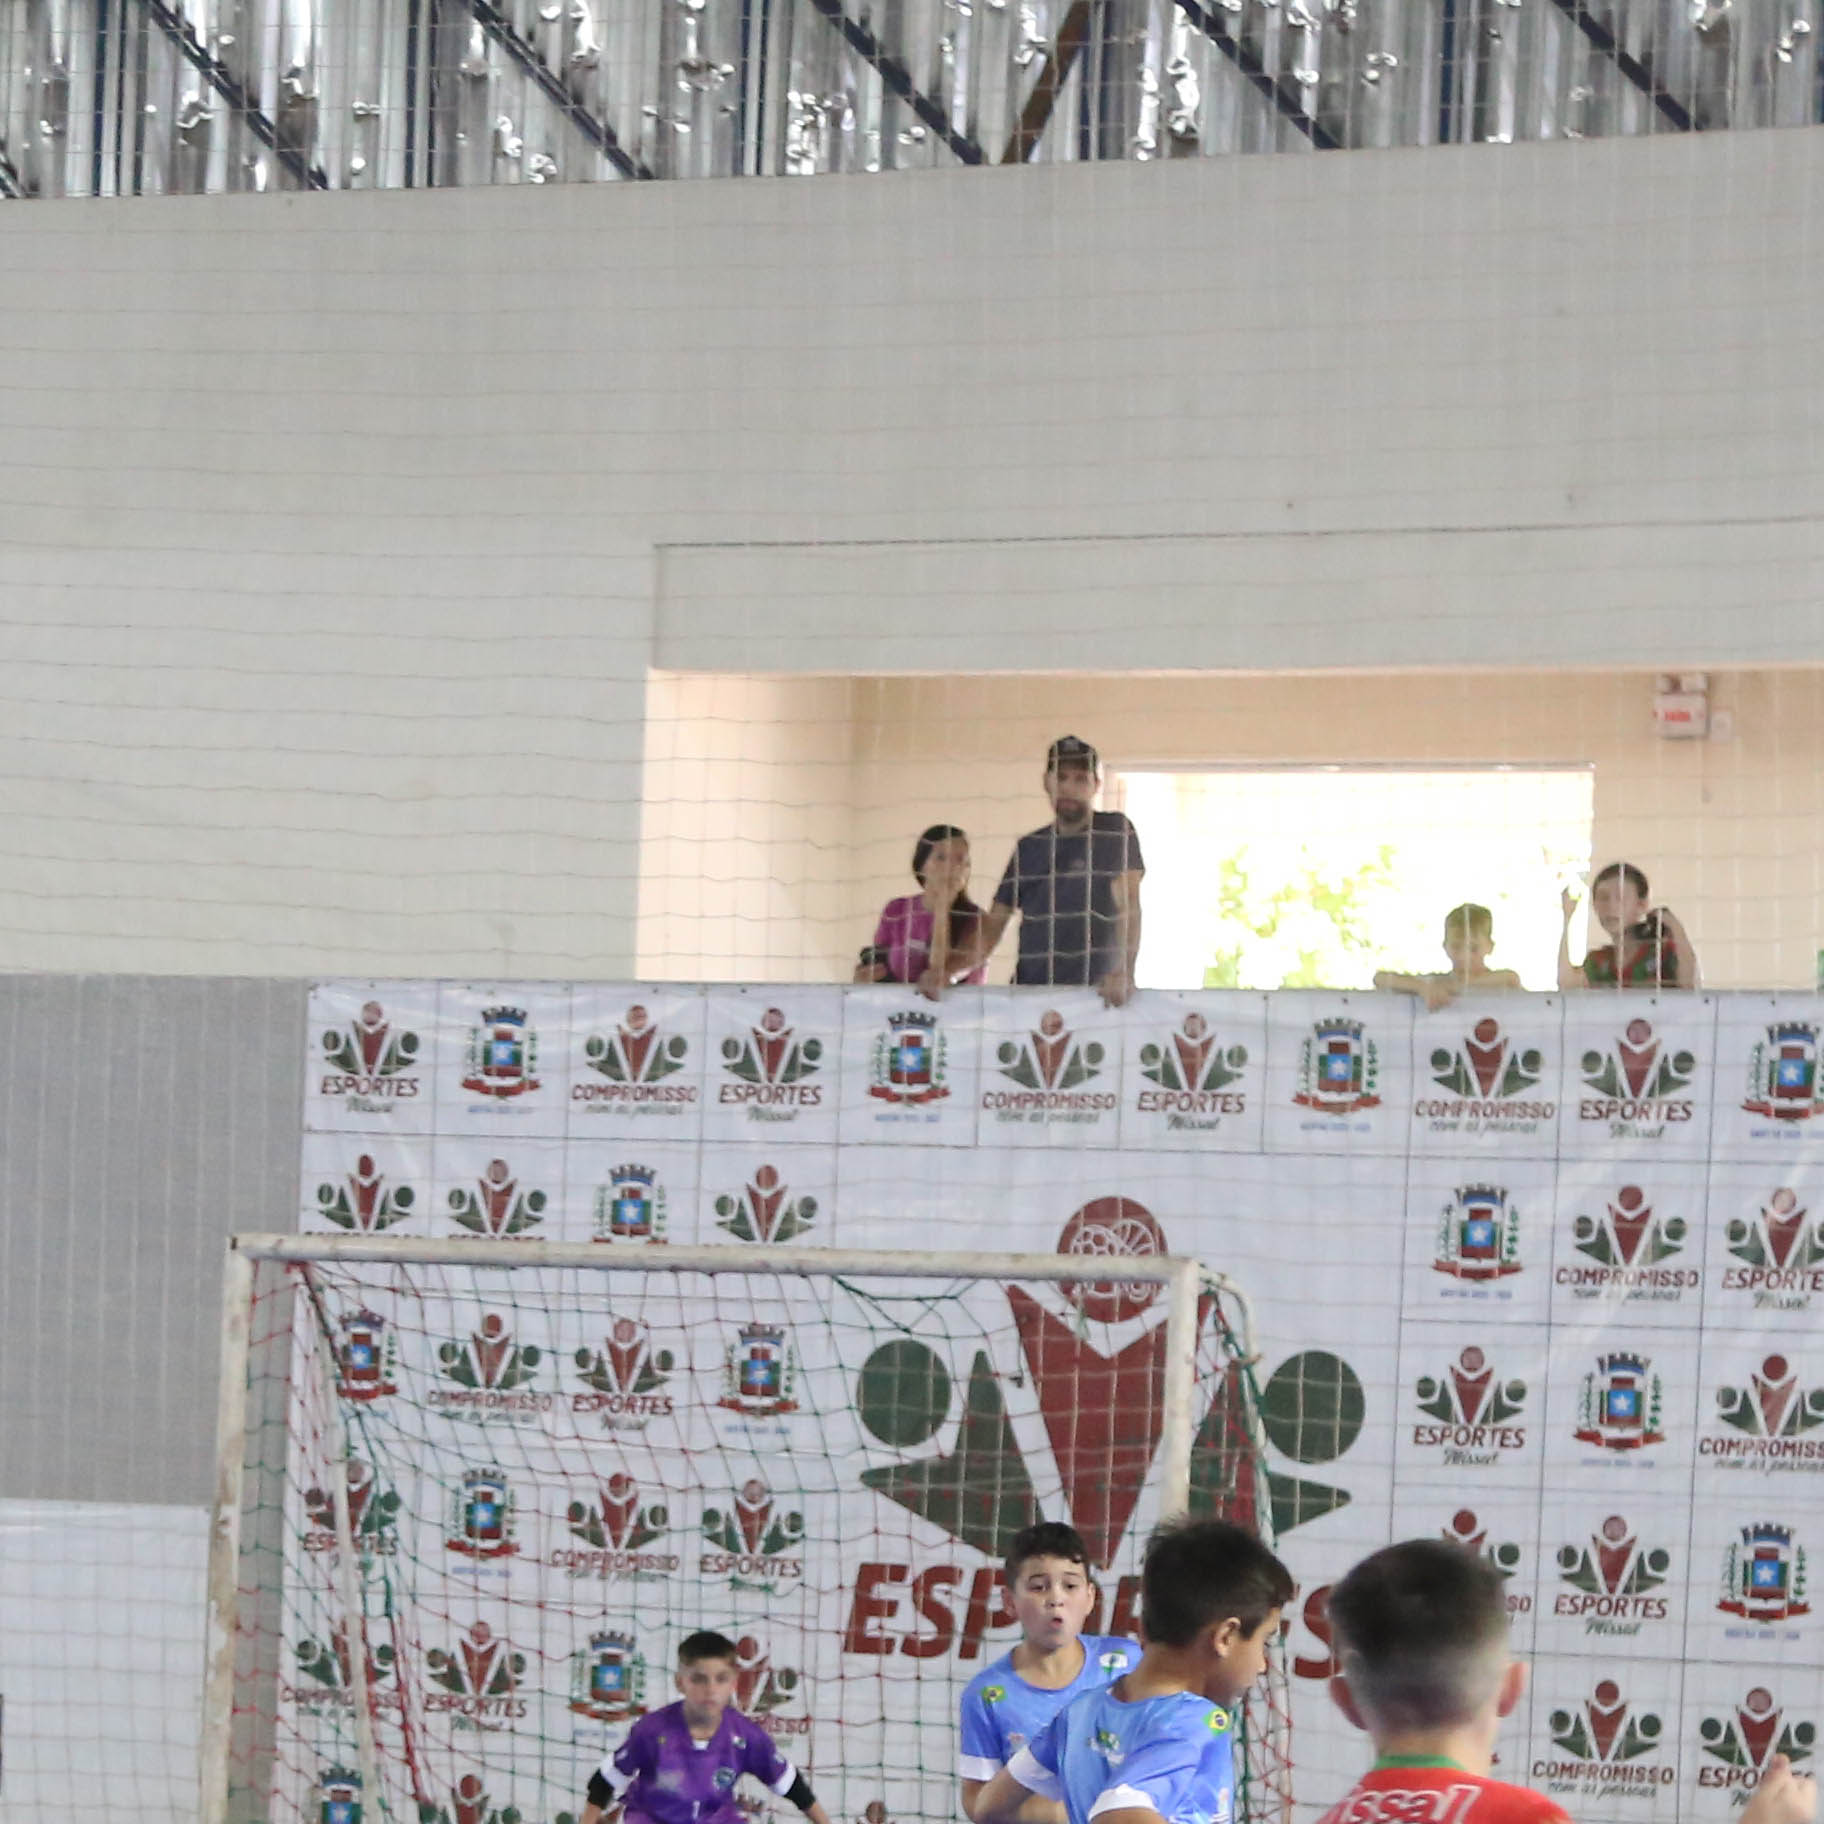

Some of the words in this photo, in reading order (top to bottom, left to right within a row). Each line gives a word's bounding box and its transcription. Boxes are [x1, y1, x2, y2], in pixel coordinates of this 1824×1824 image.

[321, 1075, 419, 1096] ESPORTES
[718, 1084, 822, 1106] ESPORTES
[983, 1091, 1117, 1110] COMPROMISSO
[1138, 1091, 1246, 1114] ESPORTES
[1415, 1099, 1555, 1120] COMPROMISSO
[1580, 1100, 1693, 1122] ESPORTES
[1555, 1266, 1699, 1289] COMPROMISSO
[572, 1394, 673, 1416] ESPORTES
[1413, 1425, 1526, 1449] ESPORTES
[700, 1554, 803, 1578] ESPORTES
[1553, 1594, 1669, 1619] ESPORTES
[1532, 1759, 1675, 1786] COMPROMISSO
